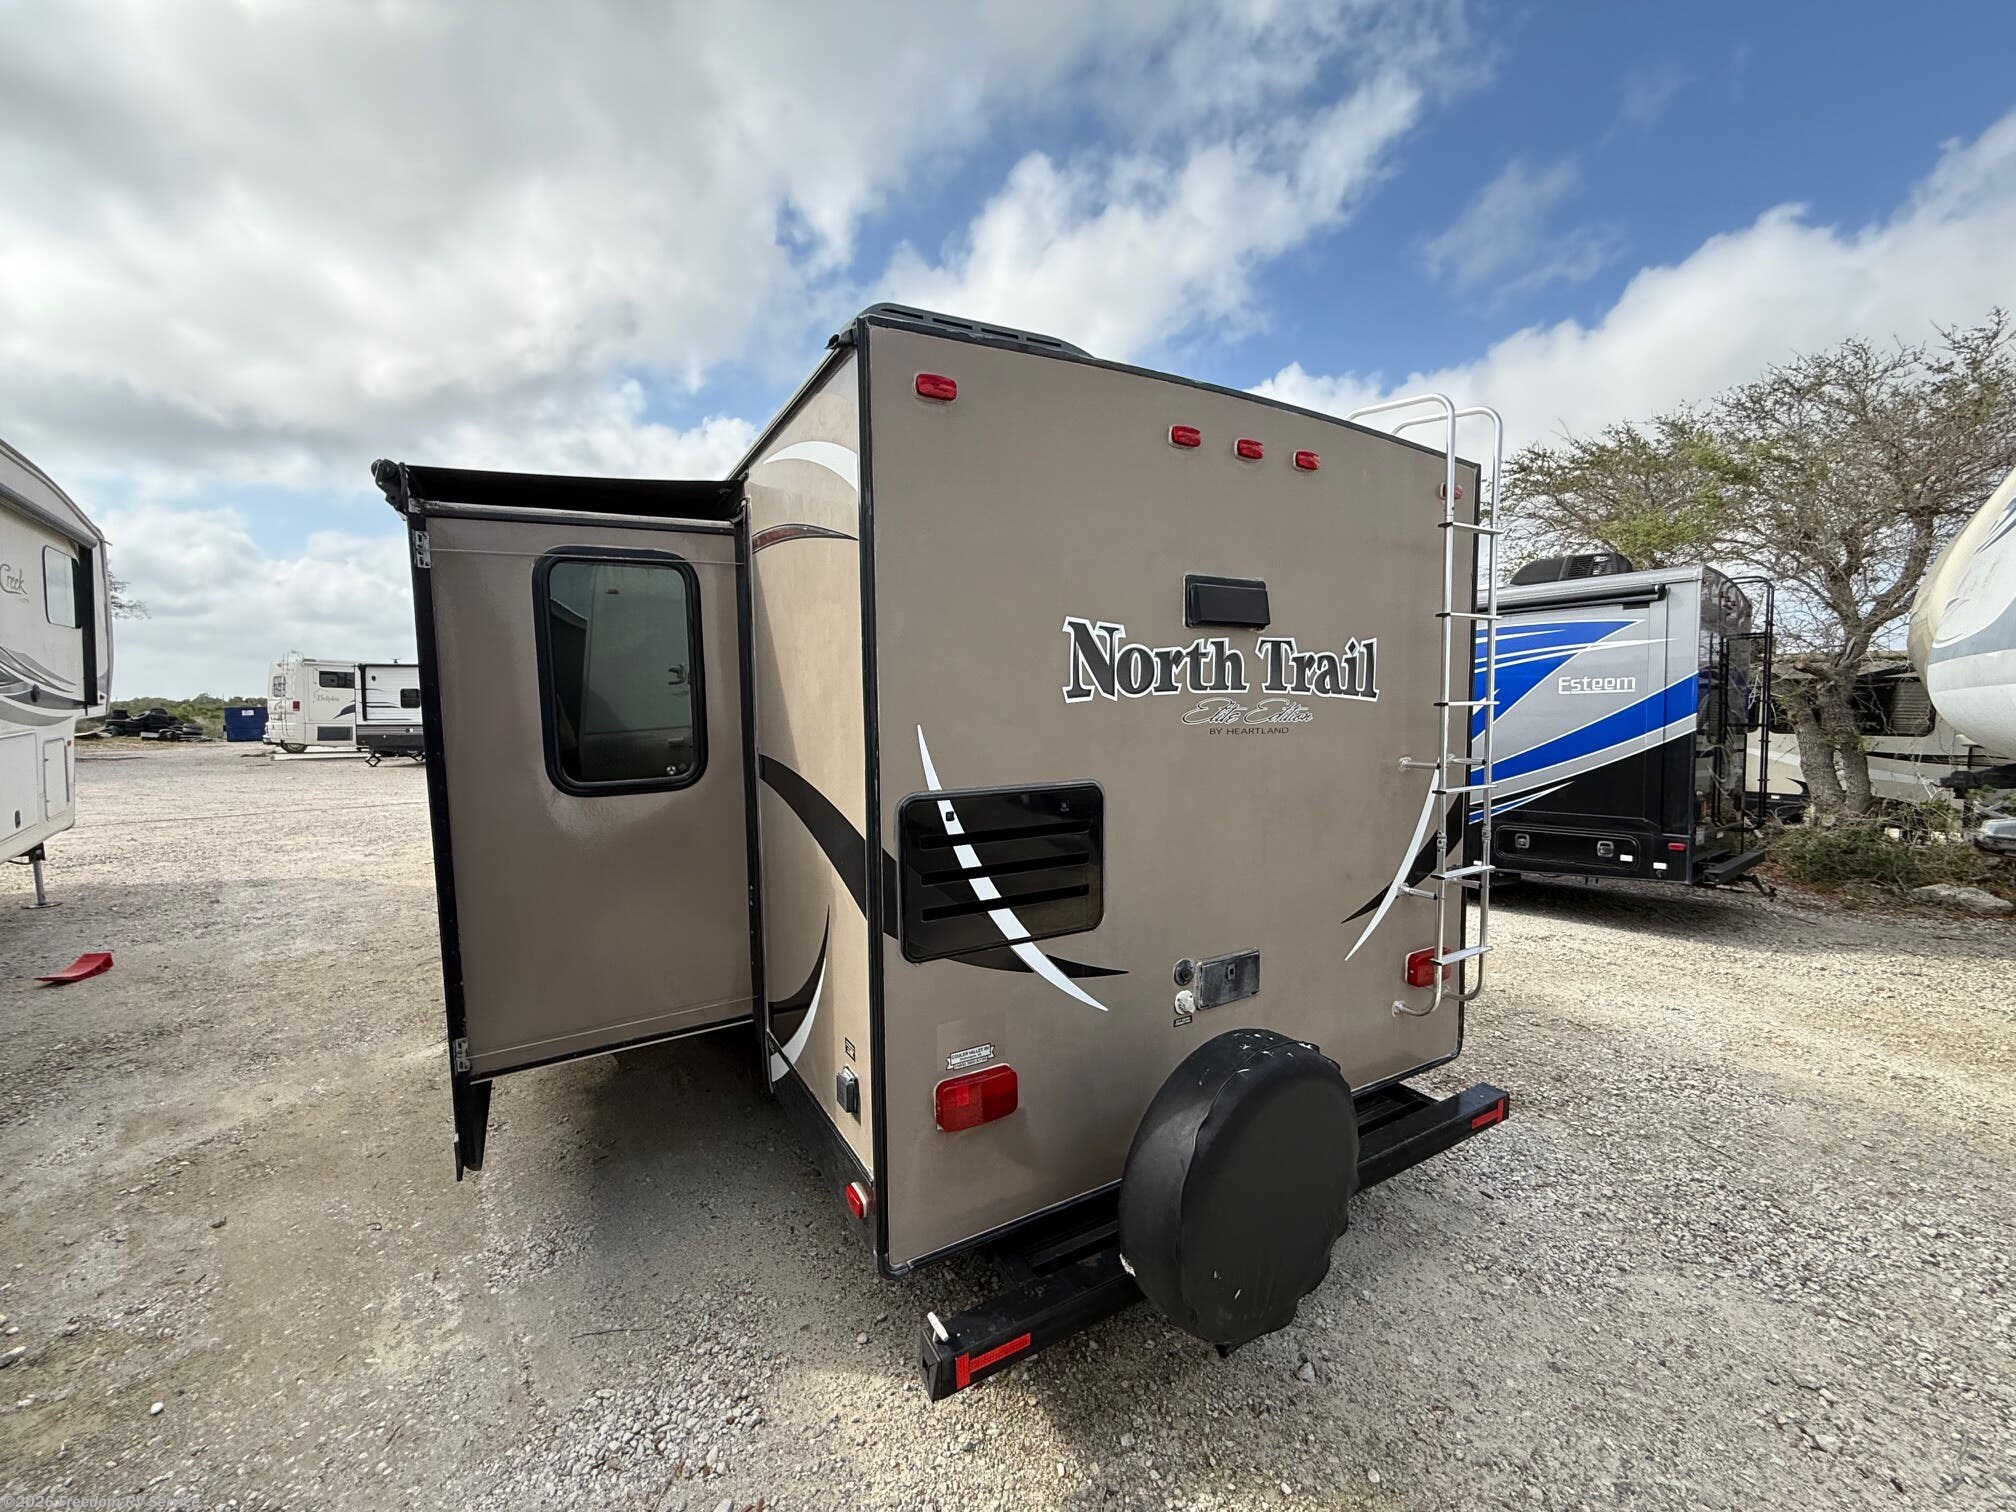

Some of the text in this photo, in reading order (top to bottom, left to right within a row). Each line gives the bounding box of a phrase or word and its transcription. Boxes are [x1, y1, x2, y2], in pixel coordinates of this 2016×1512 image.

[0, 563, 28, 595] Creek
[1062, 615, 1380, 703] North Trail
[1558, 676, 1636, 694] Esteem
[1182, 696, 1314, 725] Elite Edition
[1209, 726, 1289, 736] BY HEARTLAND
